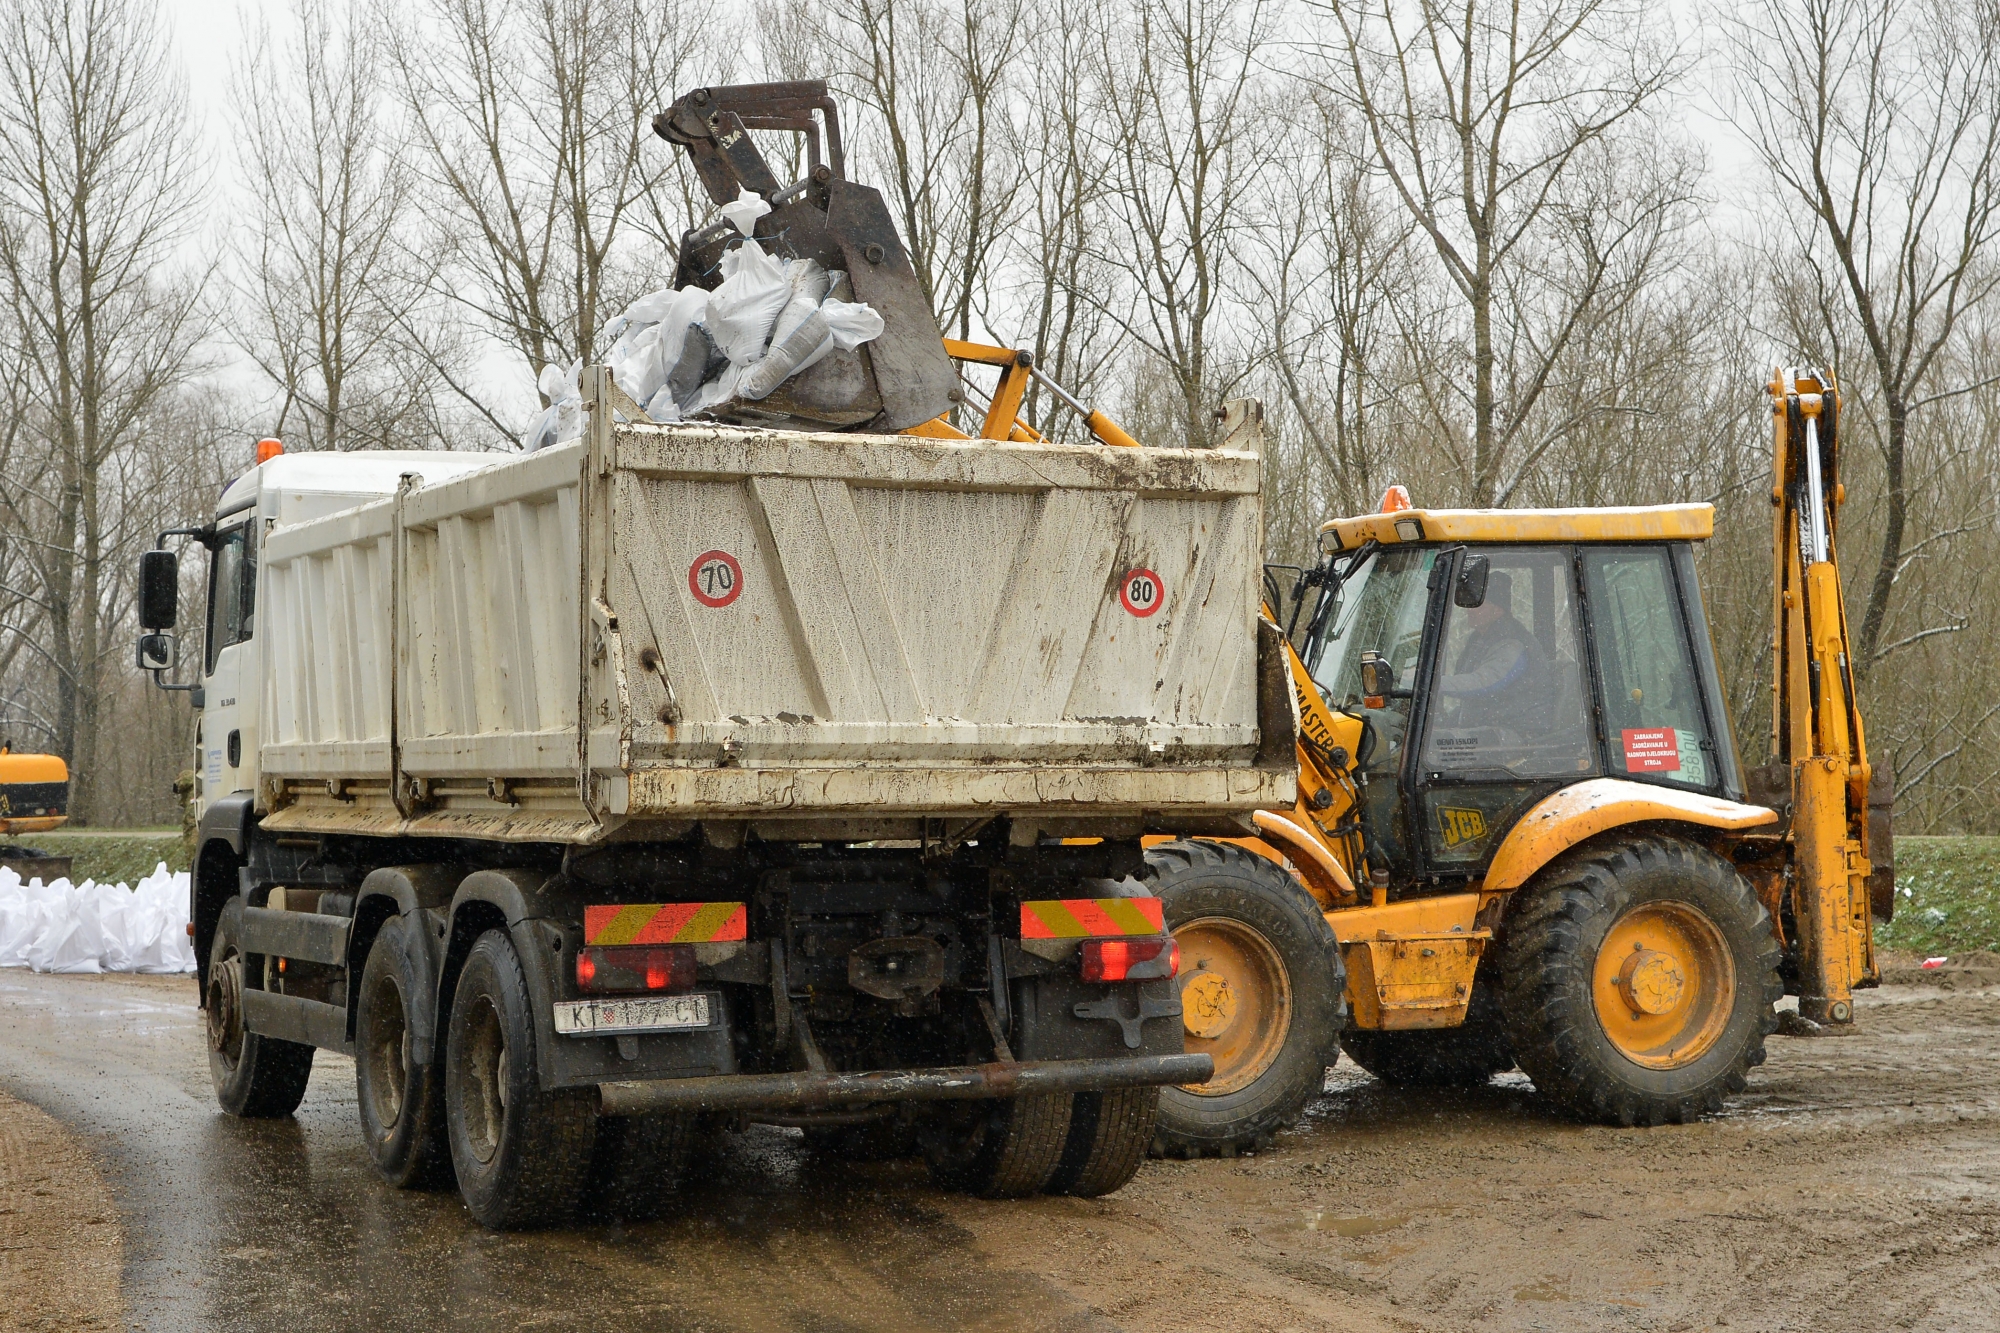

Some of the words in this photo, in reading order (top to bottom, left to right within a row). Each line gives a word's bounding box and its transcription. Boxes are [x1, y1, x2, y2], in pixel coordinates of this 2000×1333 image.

[701, 564, 732, 594] 70
[1131, 580, 1152, 602] 80
[1632, 741, 1663, 749] ZADRŽAVANJE
[1445, 810, 1483, 845] JCB
